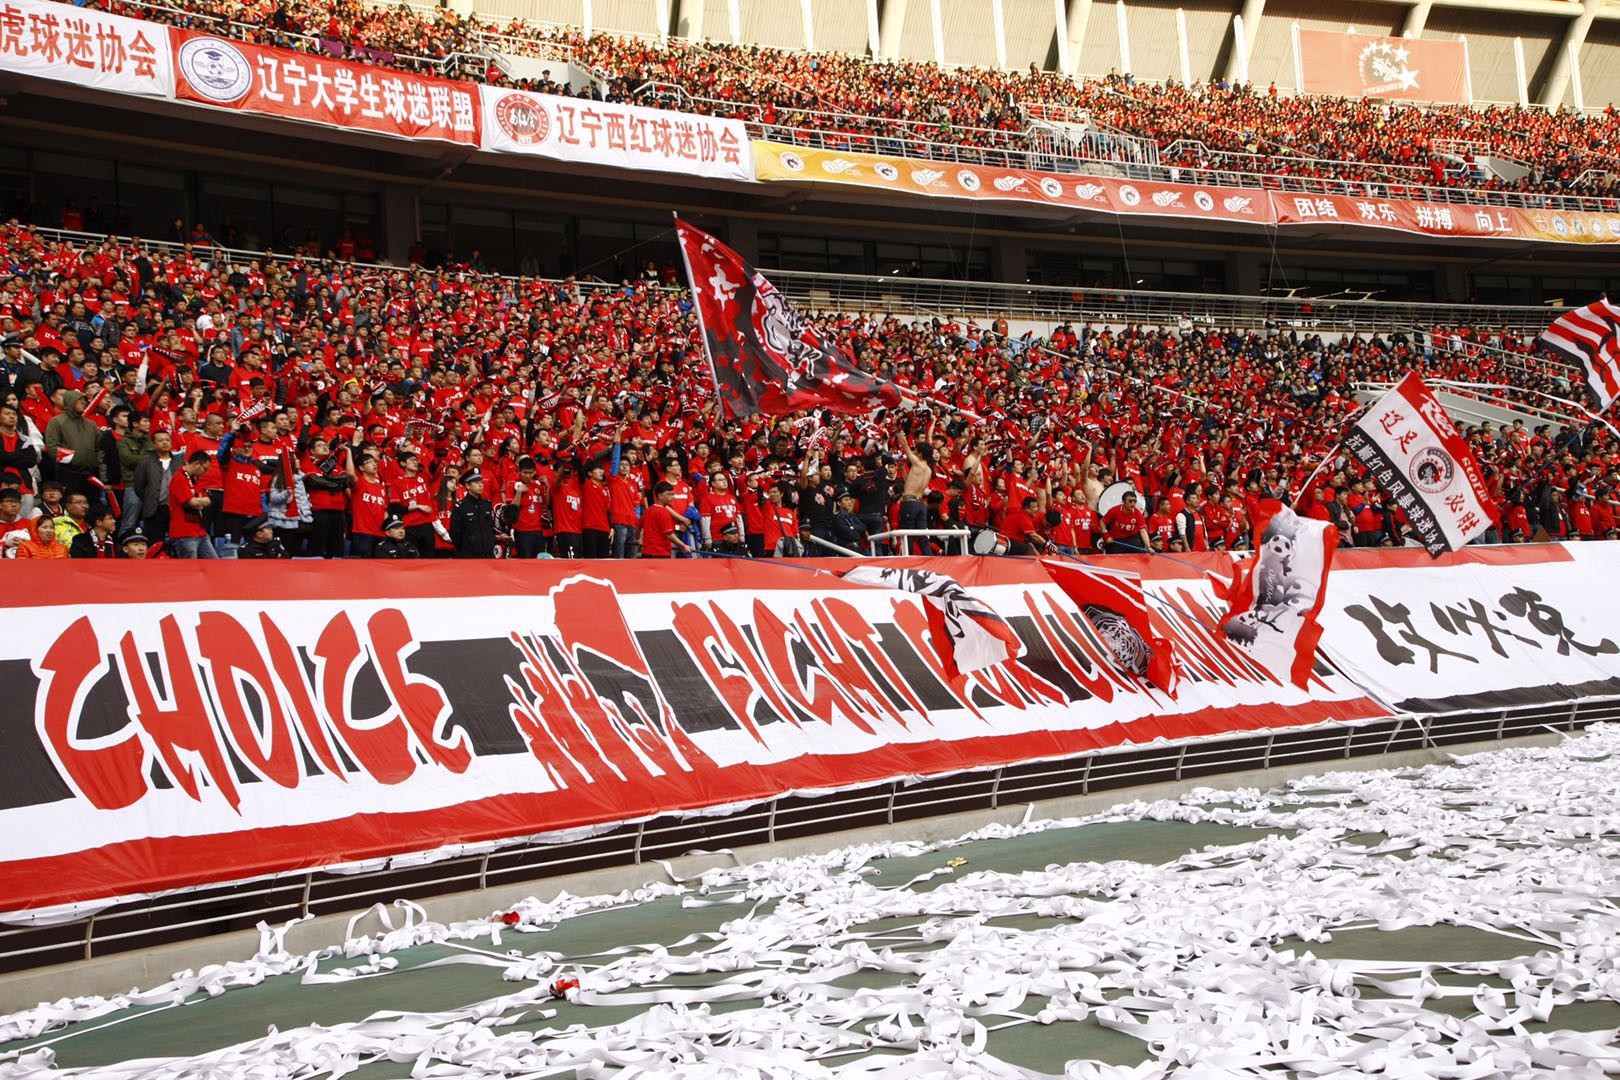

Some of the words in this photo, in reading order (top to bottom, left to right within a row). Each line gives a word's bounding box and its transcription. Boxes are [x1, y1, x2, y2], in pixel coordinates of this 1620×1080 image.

[0, 4, 156, 80] 虎球迷协会
[256, 54, 475, 133] 辽宁大学生球迷联盟
[556, 104, 741, 166] 辽宁西红球迷协会
[1015, 186, 1031, 194] CSL
[1170, 201, 1186, 209] CSL
[1295, 197, 1339, 219] 团结
[1358, 200, 1397, 223] 欢乐
[1416, 206, 1454, 230] 拼搏
[1476, 210, 1513, 233] 向上
[1345, 434, 1445, 555] 抚顺红色风暴球迷协会
[38, 607, 473, 817] CHOICE
[671, 597, 934, 753] FIGHT
